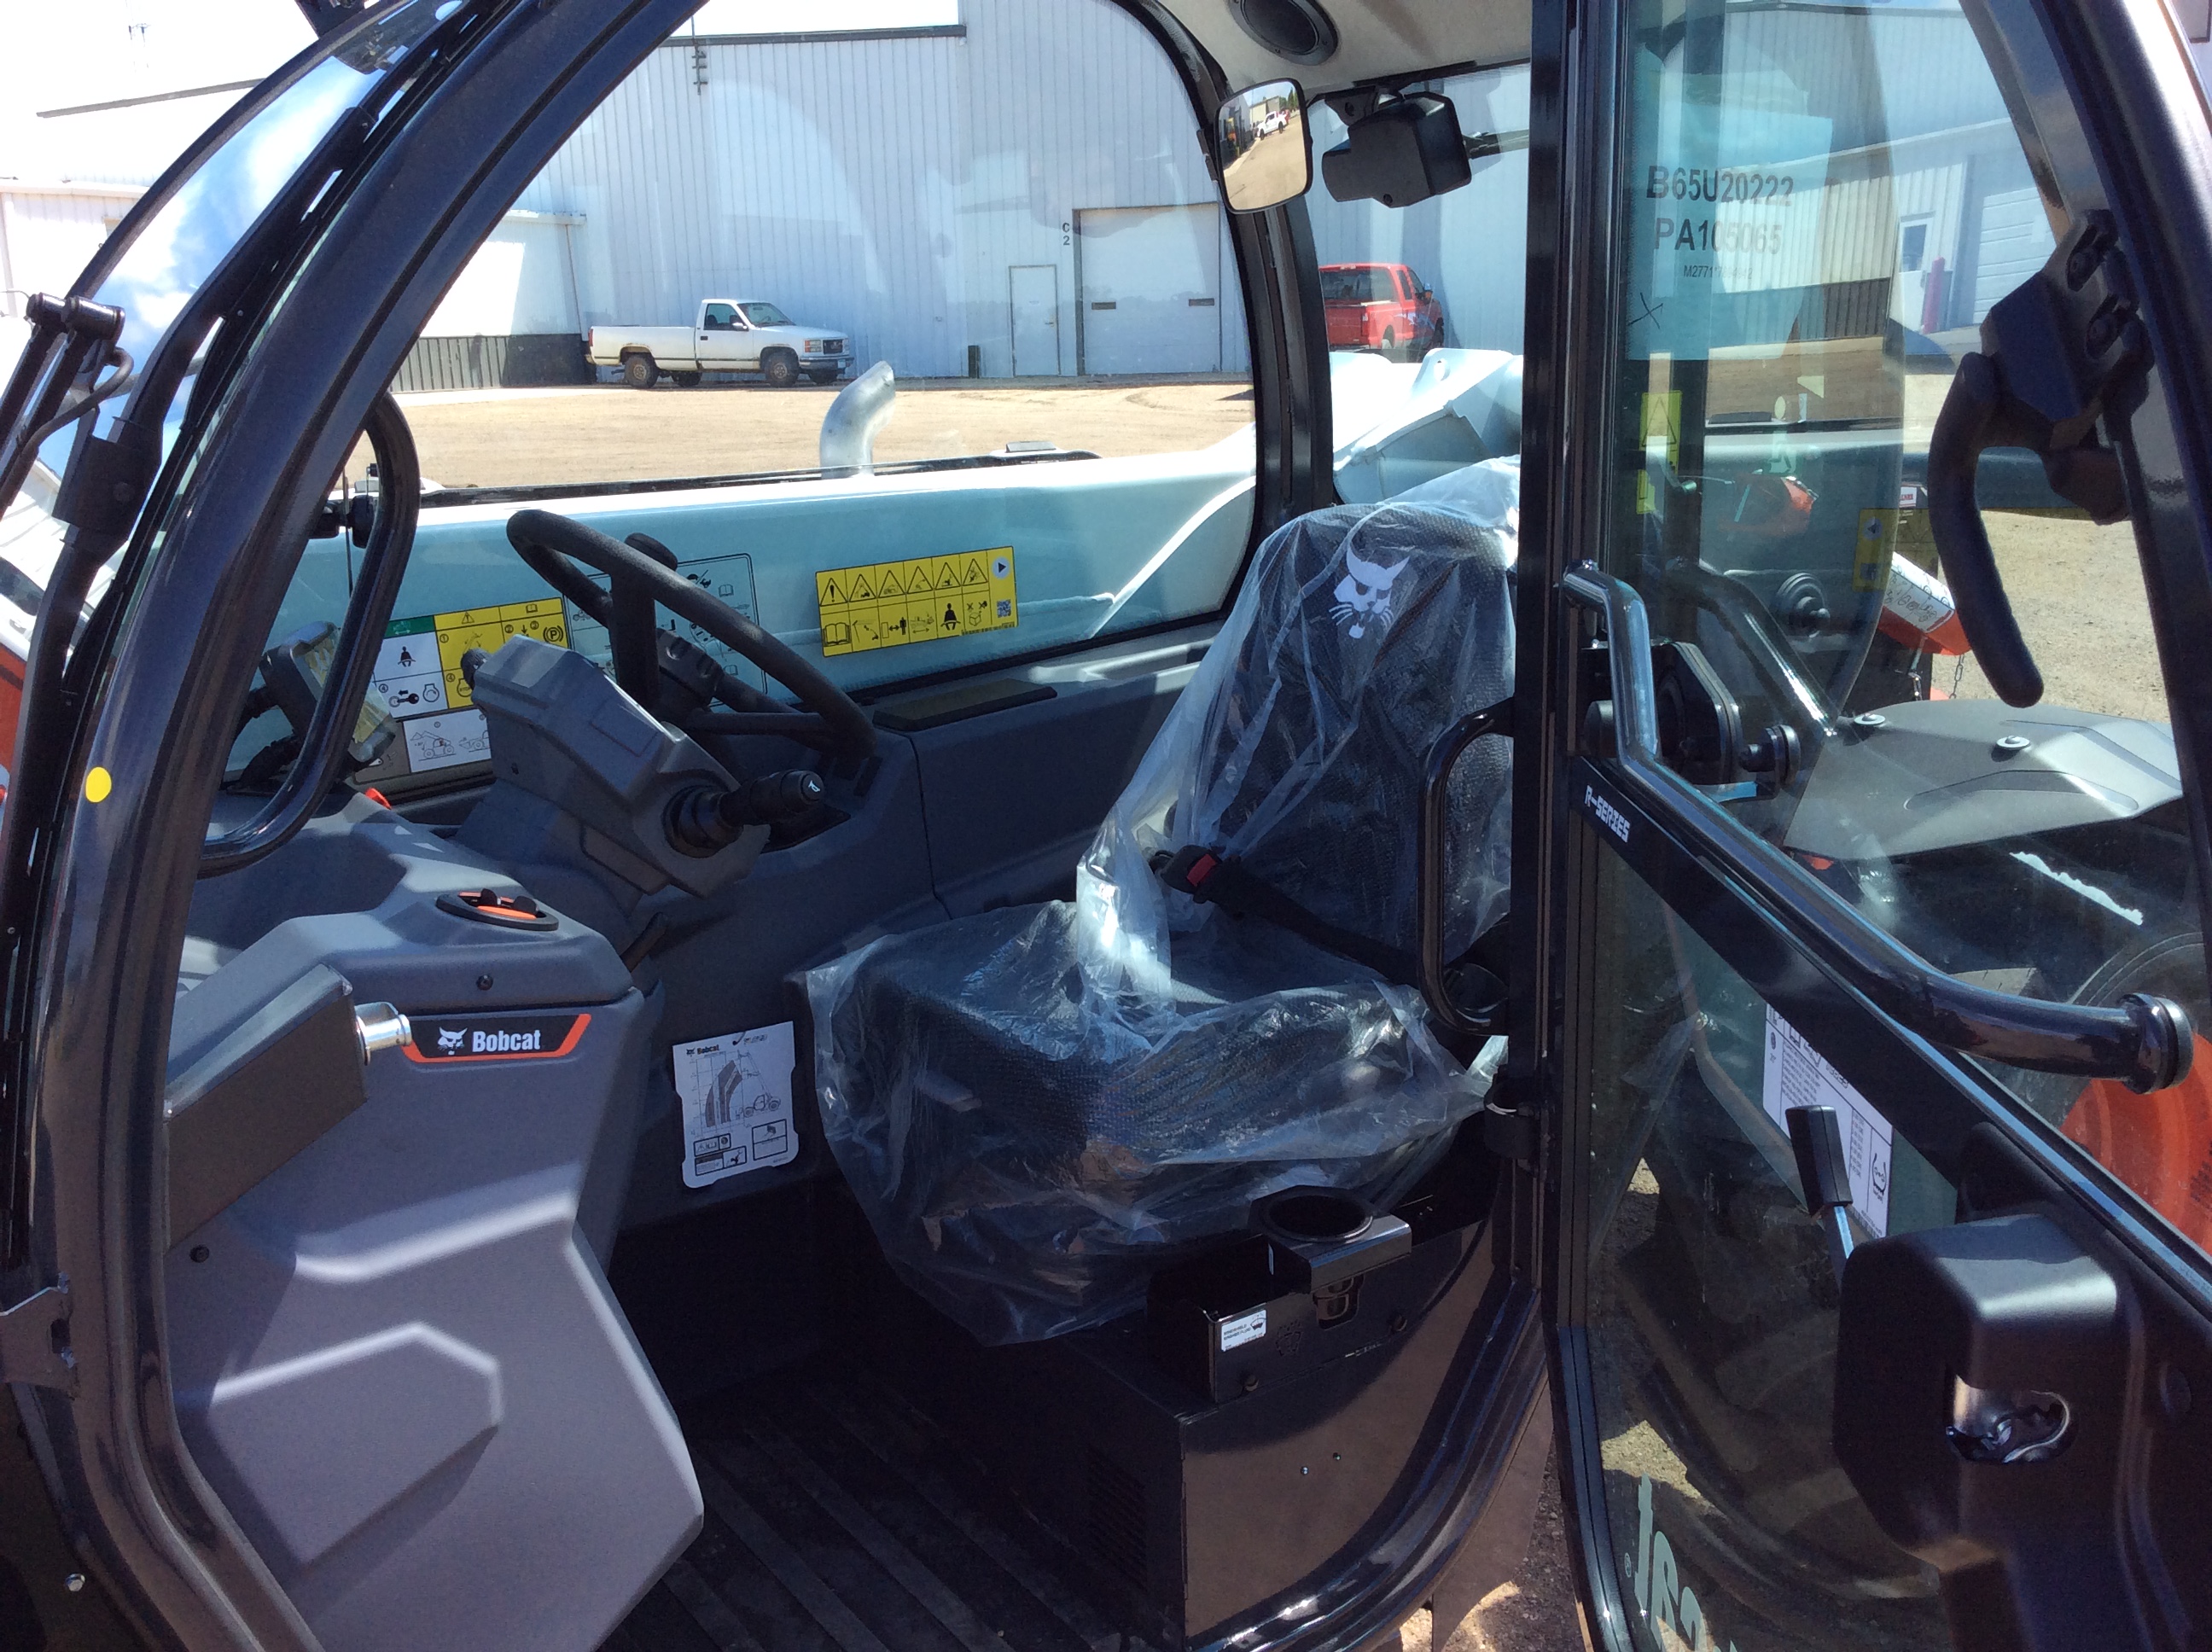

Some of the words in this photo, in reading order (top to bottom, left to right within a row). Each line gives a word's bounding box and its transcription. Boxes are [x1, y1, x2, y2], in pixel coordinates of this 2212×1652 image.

[1646, 165, 1794, 206] B65U20222
[1655, 218, 1783, 255] PA105065
[1584, 784, 1631, 843] R-SERIES
[472, 1029, 541, 1052] Bobcat
